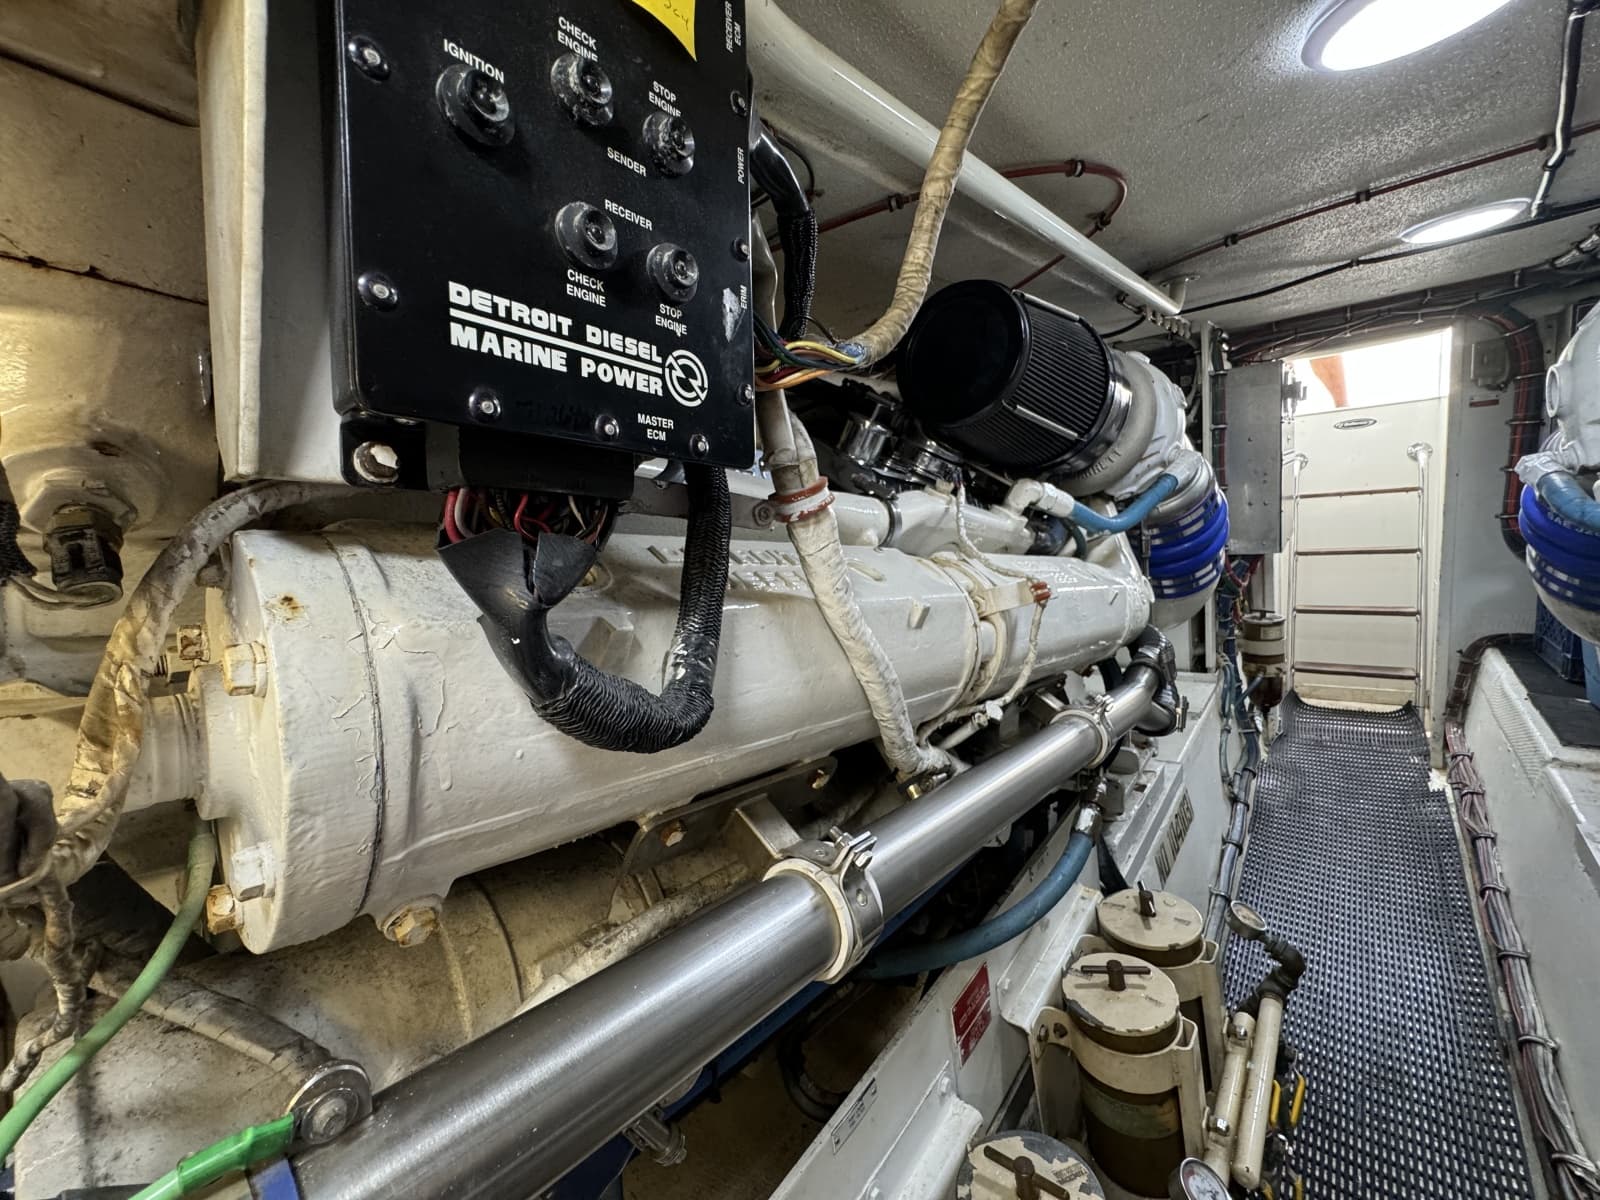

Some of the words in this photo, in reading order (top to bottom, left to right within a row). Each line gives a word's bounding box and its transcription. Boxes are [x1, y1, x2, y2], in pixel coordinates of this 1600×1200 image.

[558, 16, 597, 51] CHECK
[725, 1, 733, 53] RECEIVER
[734, 21, 742, 46] ECM
[557, 30, 598, 62] ENGINE
[443, 38, 504, 84] IGNITION
[648, 91, 682, 117] ENGINE
[653, 80, 677, 103] STOP
[607, 147, 647, 177] SENDER
[737, 146, 745, 185] POWER
[604, 199, 653, 231] RECEIVER
[567, 269, 605, 293] CHECK
[566, 285, 606, 308] ENGINE
[448, 281, 573, 336] DETROIT
[586, 324, 663, 364] DIESEL
[655, 314, 688, 336] ENGINE
[659, 303, 683, 320] STOP
[450, 321, 568, 373] MARINE
[581, 356, 663, 397] POWER
[637, 412, 674, 430] MASTER
[646, 428, 667, 442] ECM
